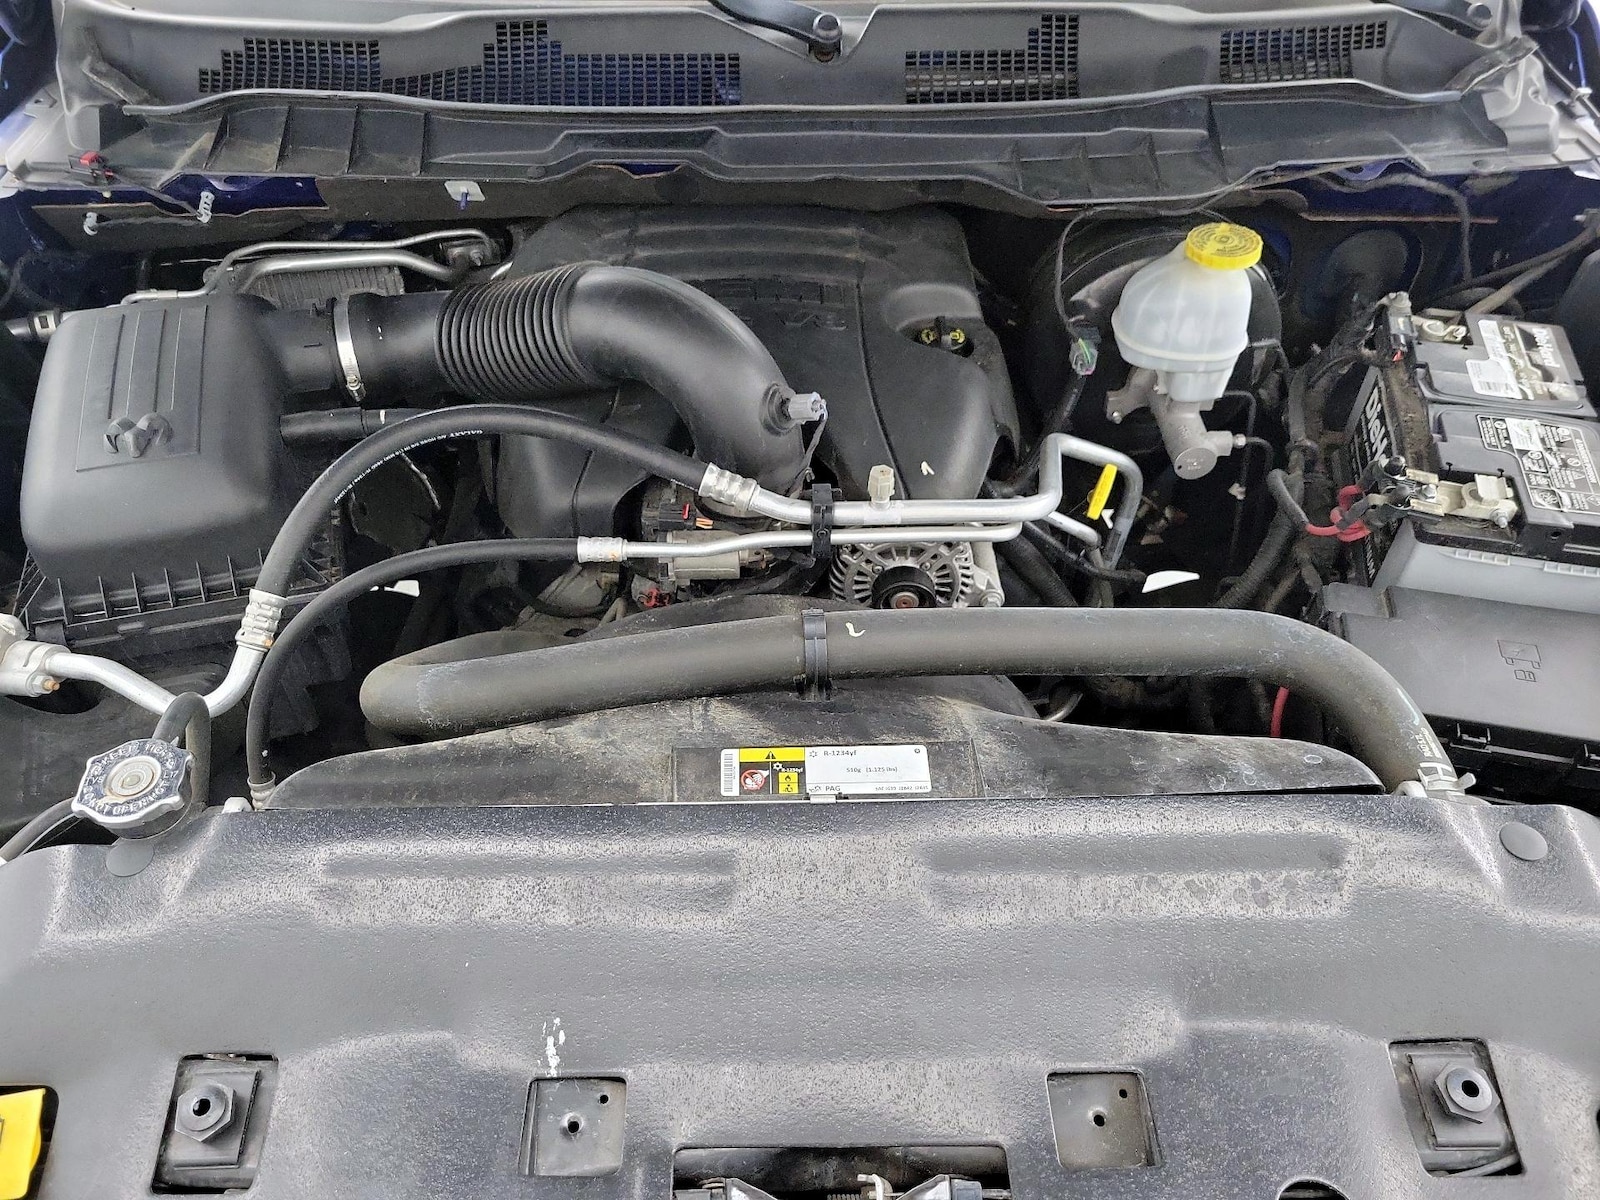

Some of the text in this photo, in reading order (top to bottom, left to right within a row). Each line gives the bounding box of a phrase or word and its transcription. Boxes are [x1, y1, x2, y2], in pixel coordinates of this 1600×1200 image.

[1531, 326, 1561, 369] DieHard
[449, 429, 484, 438] GALAXY
[823, 749, 857, 757] R-1234yf
